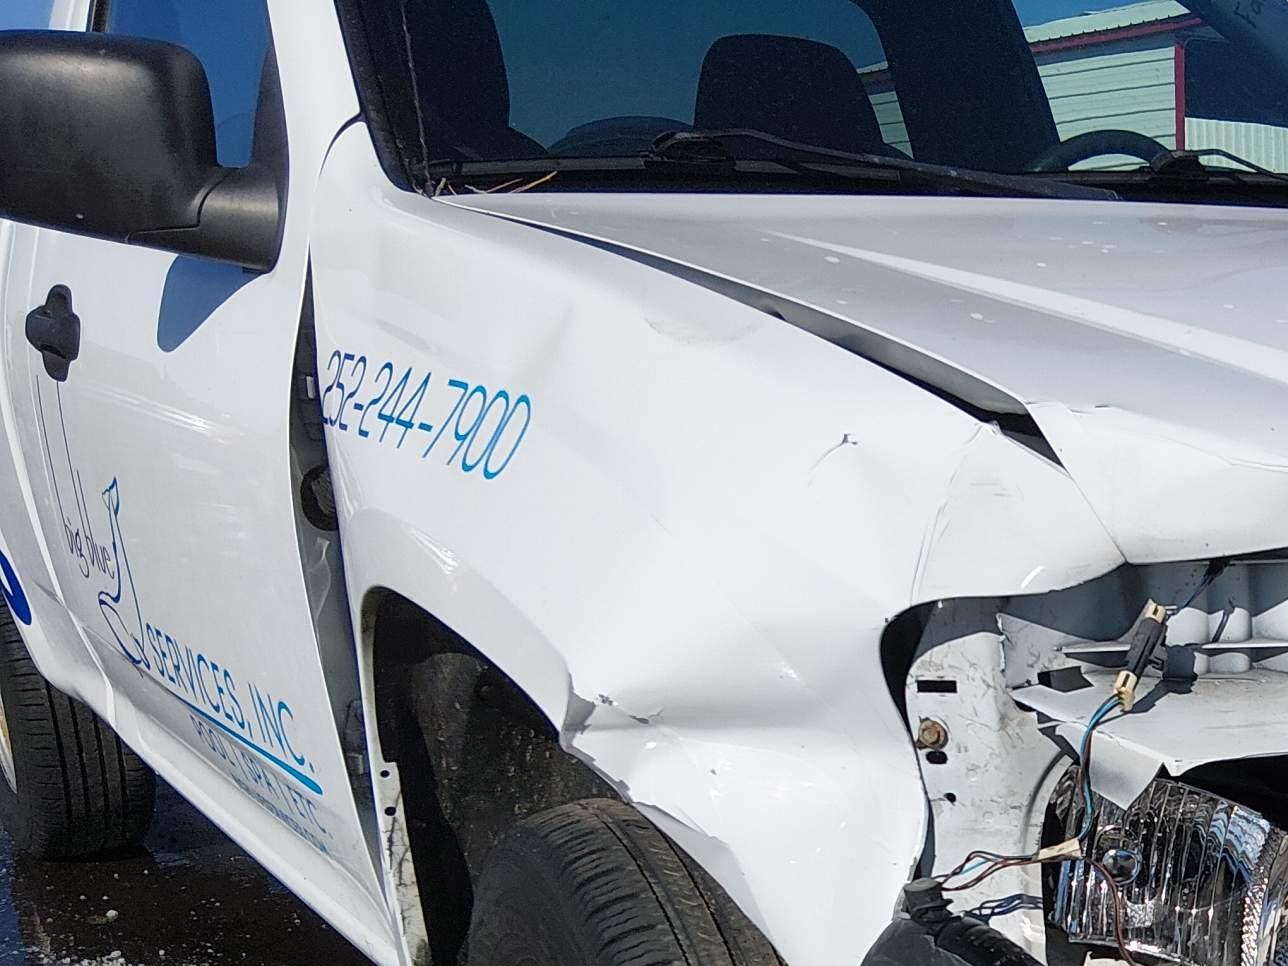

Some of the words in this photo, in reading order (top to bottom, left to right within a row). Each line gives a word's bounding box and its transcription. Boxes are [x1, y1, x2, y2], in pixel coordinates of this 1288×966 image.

[320, 350, 531, 480] 252-244-7900
[146, 622, 254, 742] SERVICES,
[247, 681, 315, 773] INC.
